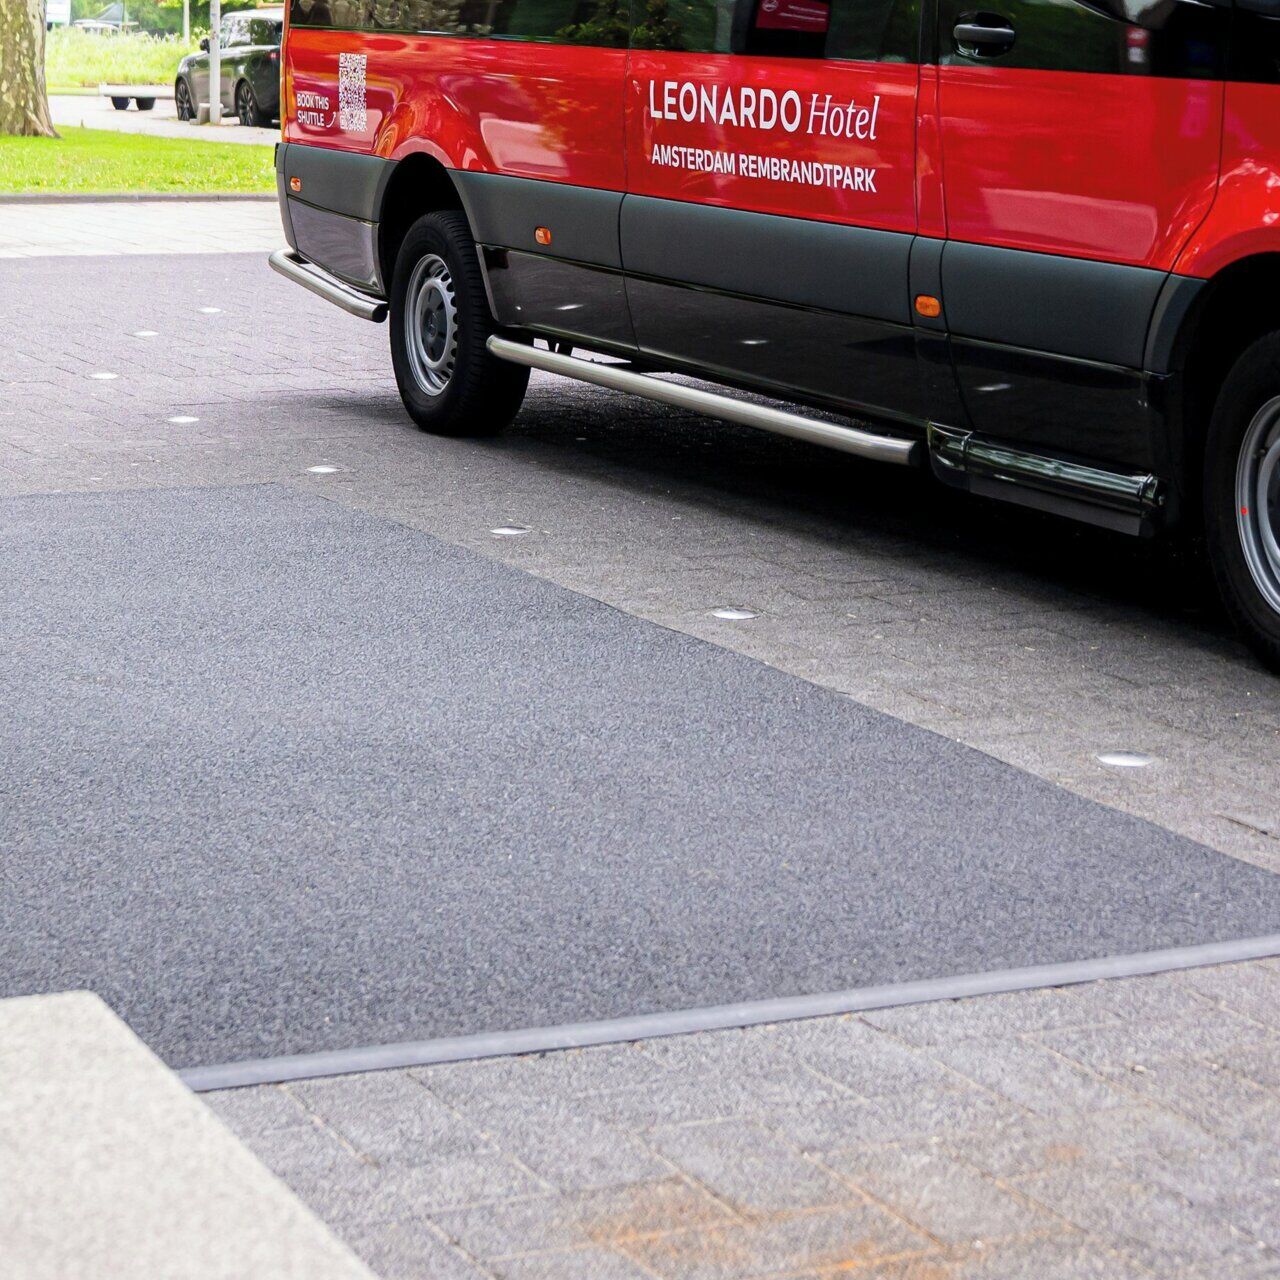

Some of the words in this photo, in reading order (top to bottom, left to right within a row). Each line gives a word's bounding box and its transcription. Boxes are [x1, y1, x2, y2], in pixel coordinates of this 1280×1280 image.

[297, 93, 315, 107] BOOK
[315, 95, 329, 110] THIS
[649, 79, 802, 133] LEONARDO
[806, 93, 880, 140] Hotel
[297, 110, 325, 127] SHUTTLE
[651, 143, 736, 175] AMSTERDAM
[739, 154, 877, 193] REMBRANDTPARK
